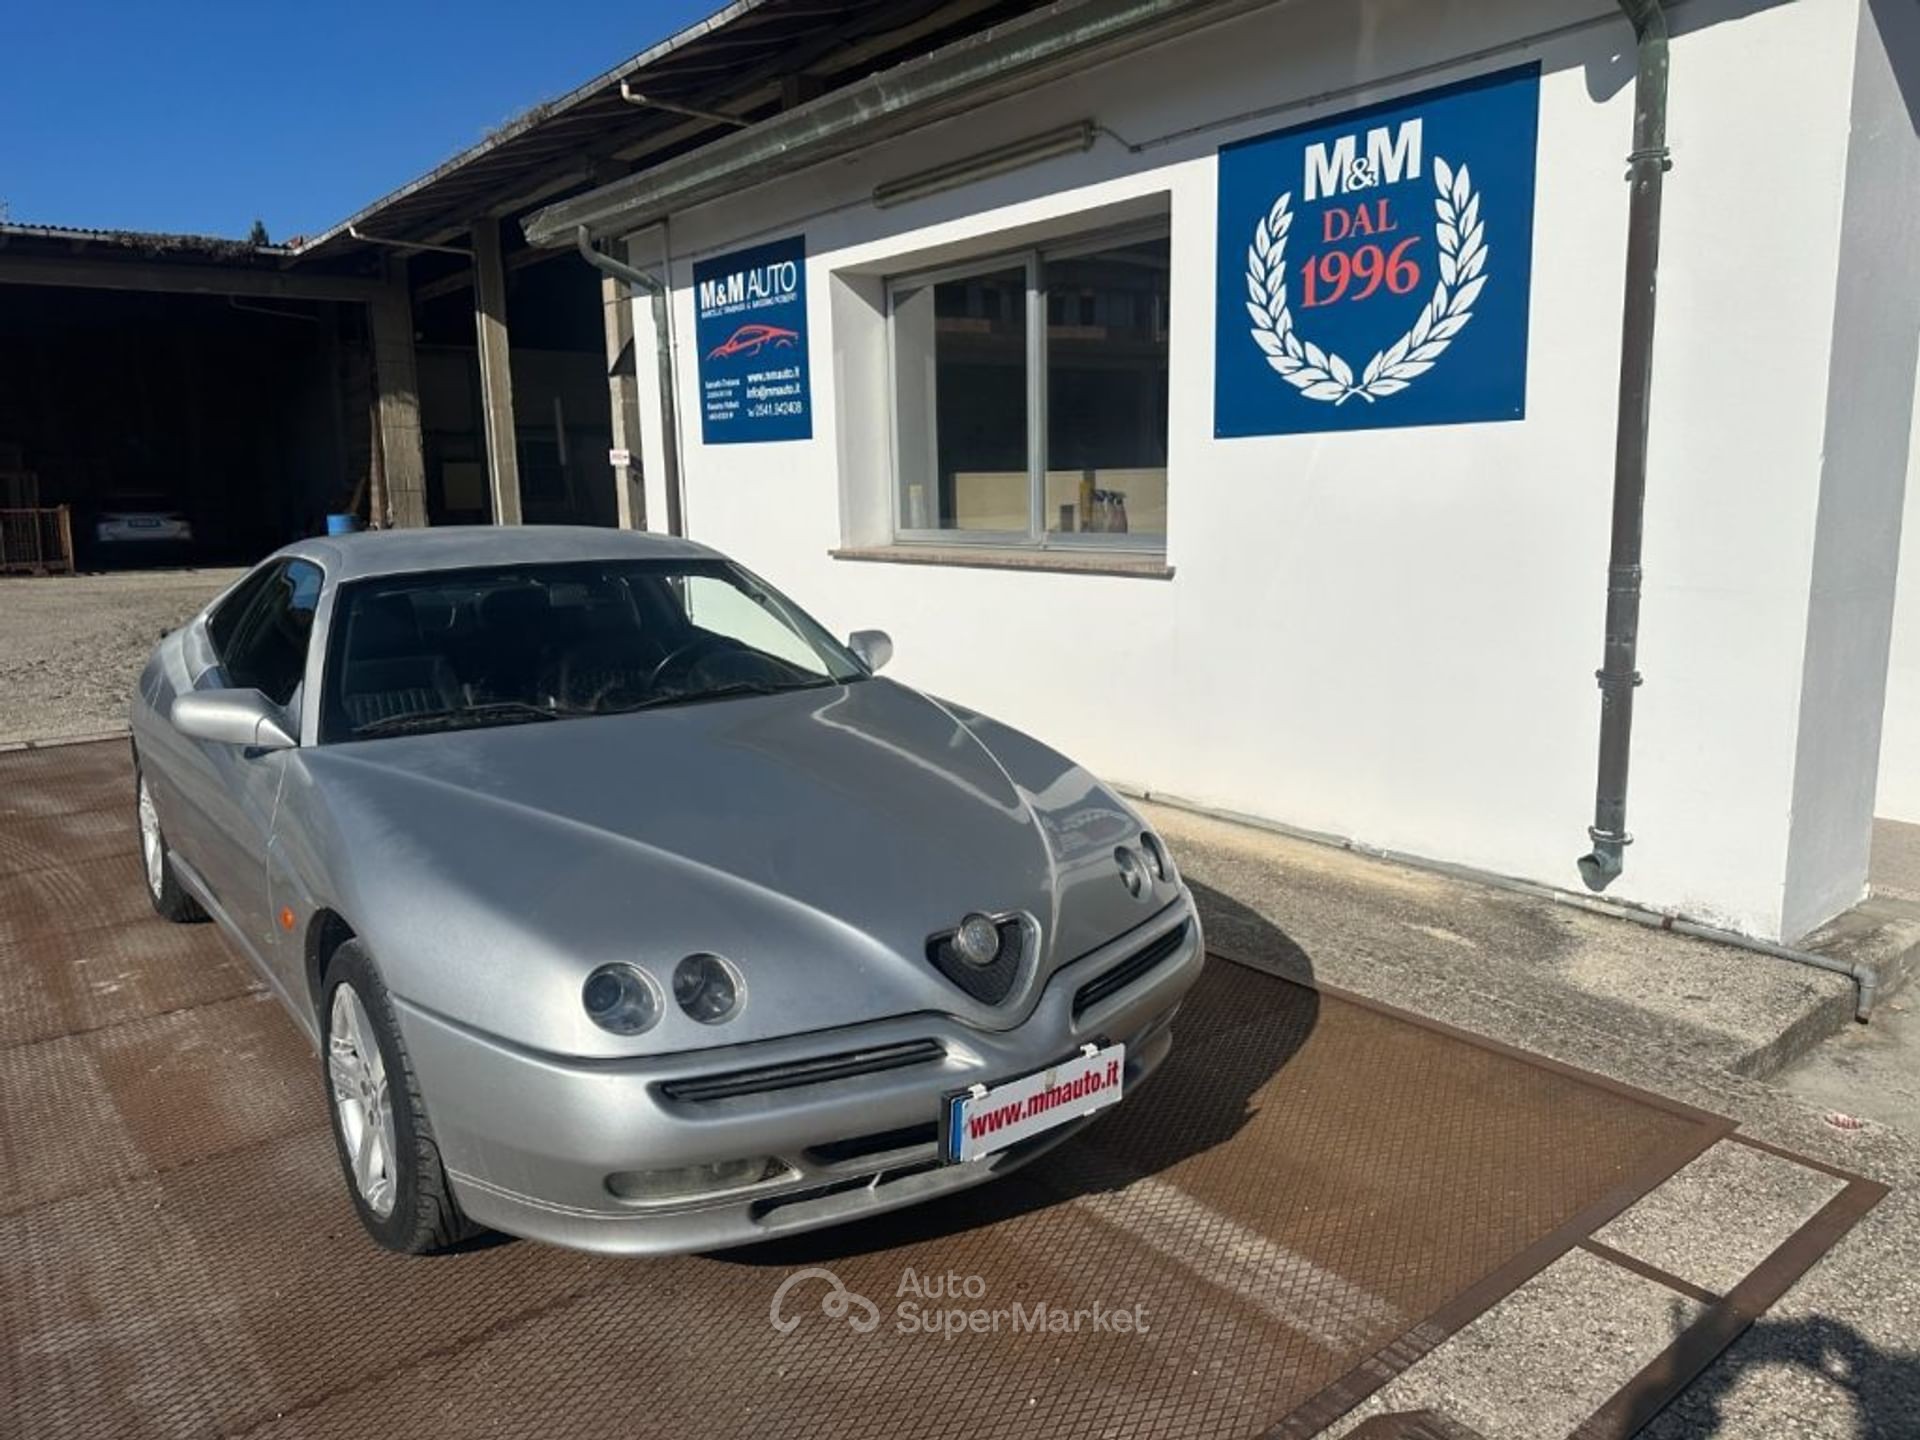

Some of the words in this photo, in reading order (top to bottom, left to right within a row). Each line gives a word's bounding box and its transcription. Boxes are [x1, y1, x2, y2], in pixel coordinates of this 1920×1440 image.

[1304, 117, 1423, 201] M&M
[1322, 198, 1398, 243] DAL
[700, 272, 744, 310] M&M
[747, 261, 796, 299] AUTO
[1300, 236, 1421, 309] 1996
[970, 1060, 1120, 1140] www.mmauto.it
